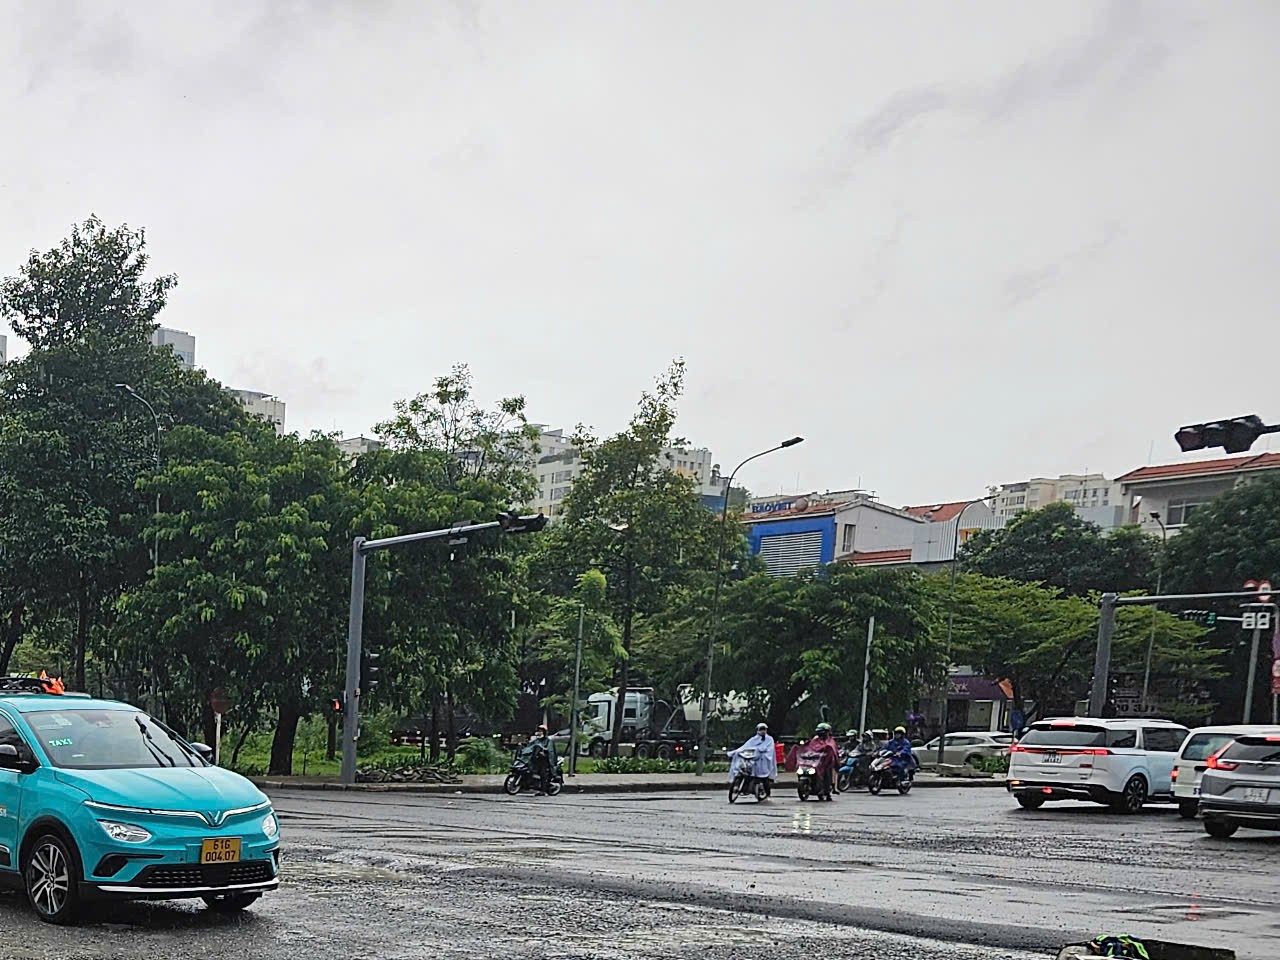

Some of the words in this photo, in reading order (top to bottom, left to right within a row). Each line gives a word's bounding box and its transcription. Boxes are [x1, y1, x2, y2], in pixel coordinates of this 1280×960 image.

[48, 738, 73, 747] TAXI
[213, 839, 231, 850] 61G
[205, 850, 236, 862] 004.07
